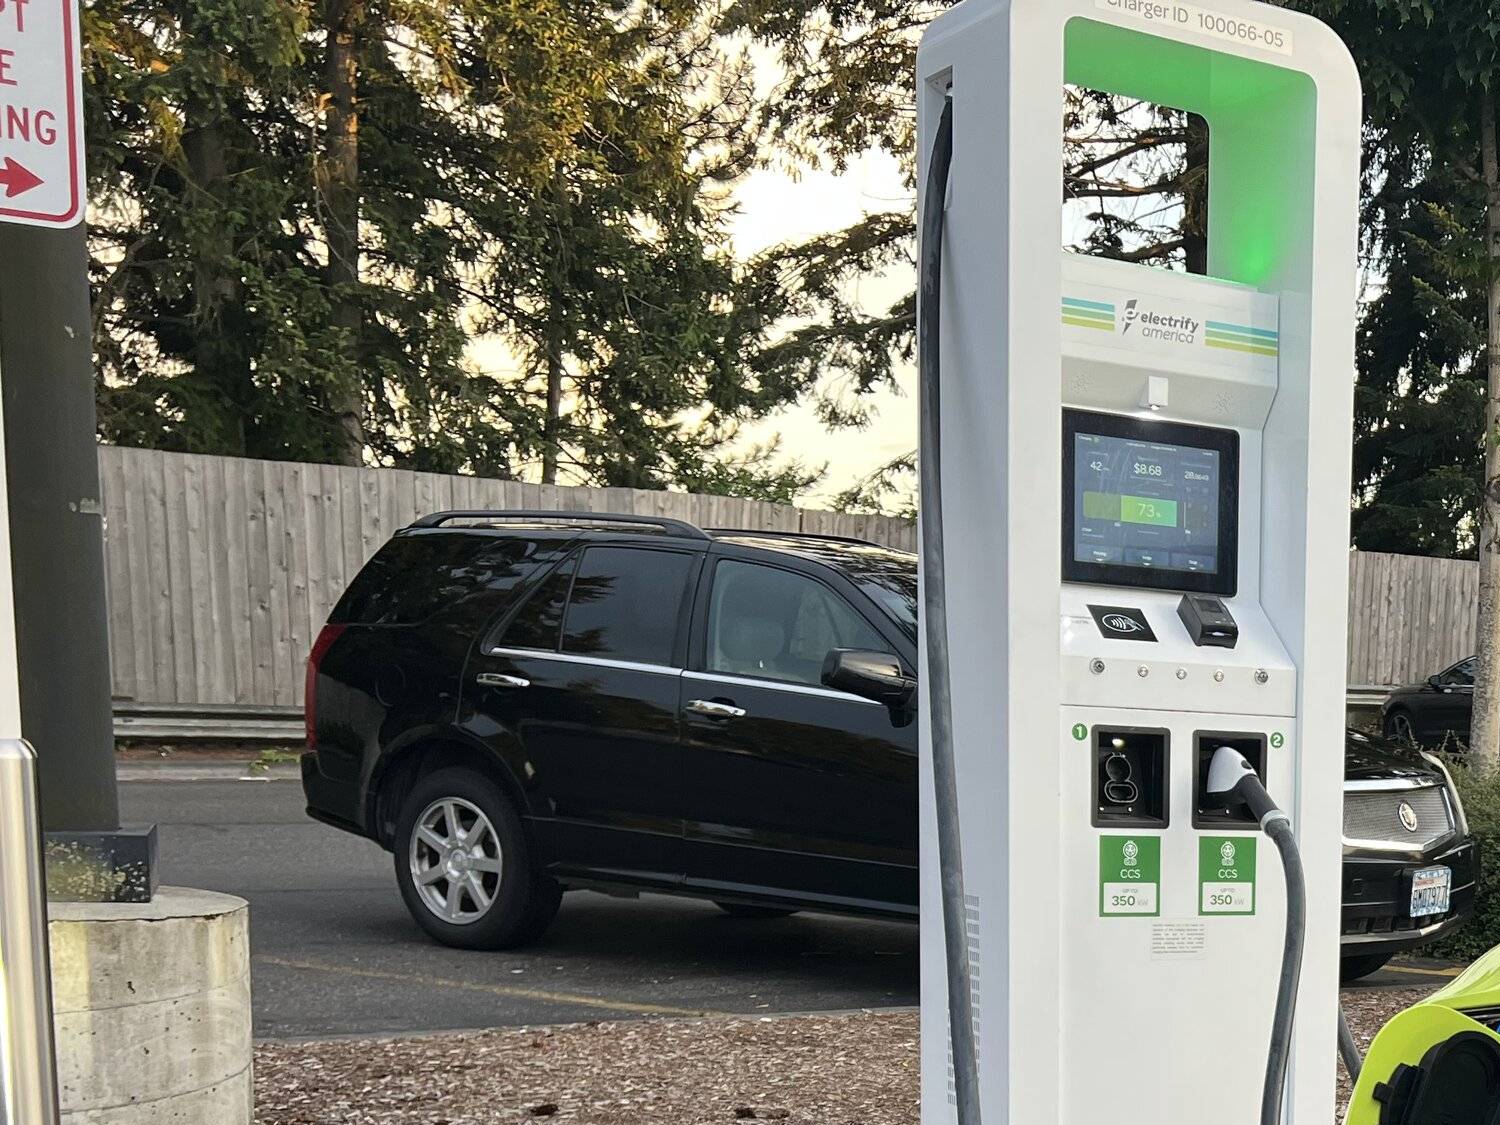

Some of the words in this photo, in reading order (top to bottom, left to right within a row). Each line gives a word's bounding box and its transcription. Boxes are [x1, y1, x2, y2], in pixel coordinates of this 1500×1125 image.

[1173, 6, 1189, 23] ID
[1197, 13, 1284, 48] 100066-05
[1141, 311, 1199, 334] electrify
[1142, 327, 1195, 344] america
[1090, 461, 1102, 471] 42
[1133, 462, 1162, 477] $8.68
[1120, 868, 1141, 879] CCS
[1218, 868, 1238, 879] CCS
[1111, 895, 1136, 906] 350
[1210, 894, 1233, 905] 350
